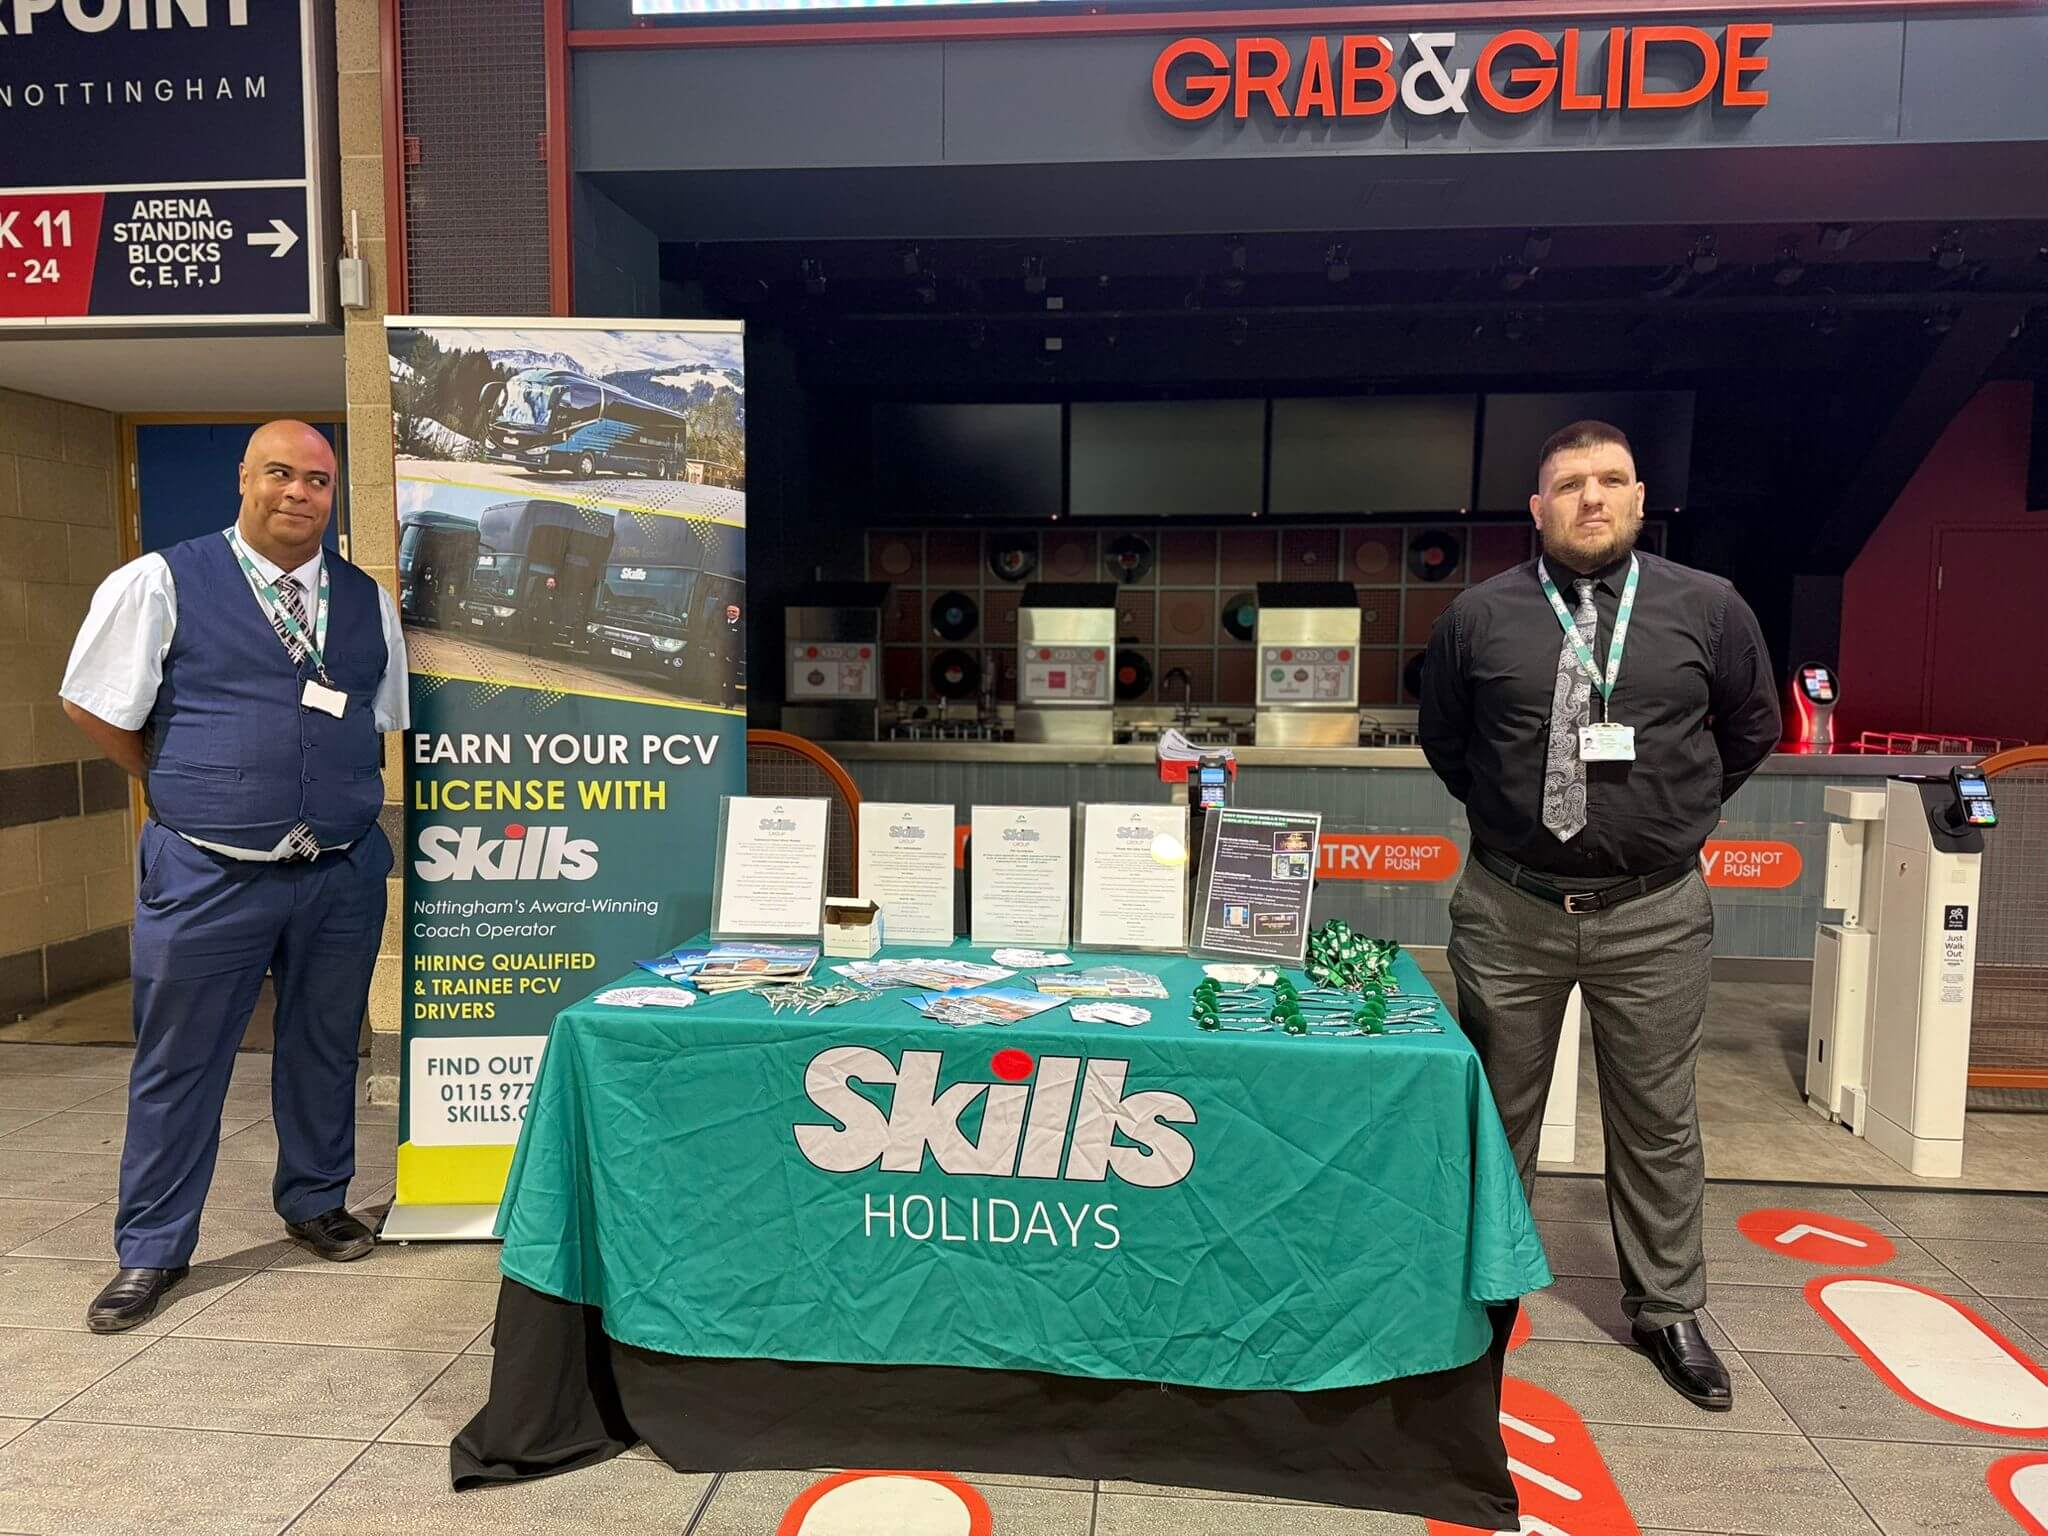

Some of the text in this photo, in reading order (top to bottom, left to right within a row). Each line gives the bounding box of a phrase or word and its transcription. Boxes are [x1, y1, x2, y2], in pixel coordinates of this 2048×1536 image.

[0, 0, 248, 35] POIN
[0, 76, 267, 107] NOTTINGHAM
[132, 199, 213, 220] ARENA
[33, 209, 72, 248] 11
[113, 220, 234, 243] STANDING
[128, 243, 222, 264] BLOCKS
[23, 258, 61, 284] 24
[129, 264, 221, 288] C, E, F, J
[414, 733, 720, 765] EARN YOUR PCV
[414, 779, 666, 811] LICENSE WITH
[414, 823, 600, 882] Skills
[1385, 845, 1407, 857] DO
[1410, 845, 1441, 858] NOT
[1724, 850, 1748, 863] DO
[1750, 851, 1784, 864] NOT
[1384, 858, 1421, 871] PUSH
[1723, 864, 1761, 877] PUSH
[413, 899, 659, 918] Nottingham's Award-Winning
[413, 922, 557, 939] Coach Operator
[1945, 942, 1965, 950] Walk
[1946, 950, 1962, 958] Out
[414, 953, 596, 972] HIRING QUALIFIED
[413, 977, 562, 995] & TRAINEE PCV
[414, 1002, 495, 1020] DRIVERS
[427, 1056, 534, 1076] FIND OUT
[440, 1084, 492, 1101] 0115
[792, 1044, 1198, 1189] Skills
[864, 1193, 1122, 1251] HOLIDAYS
